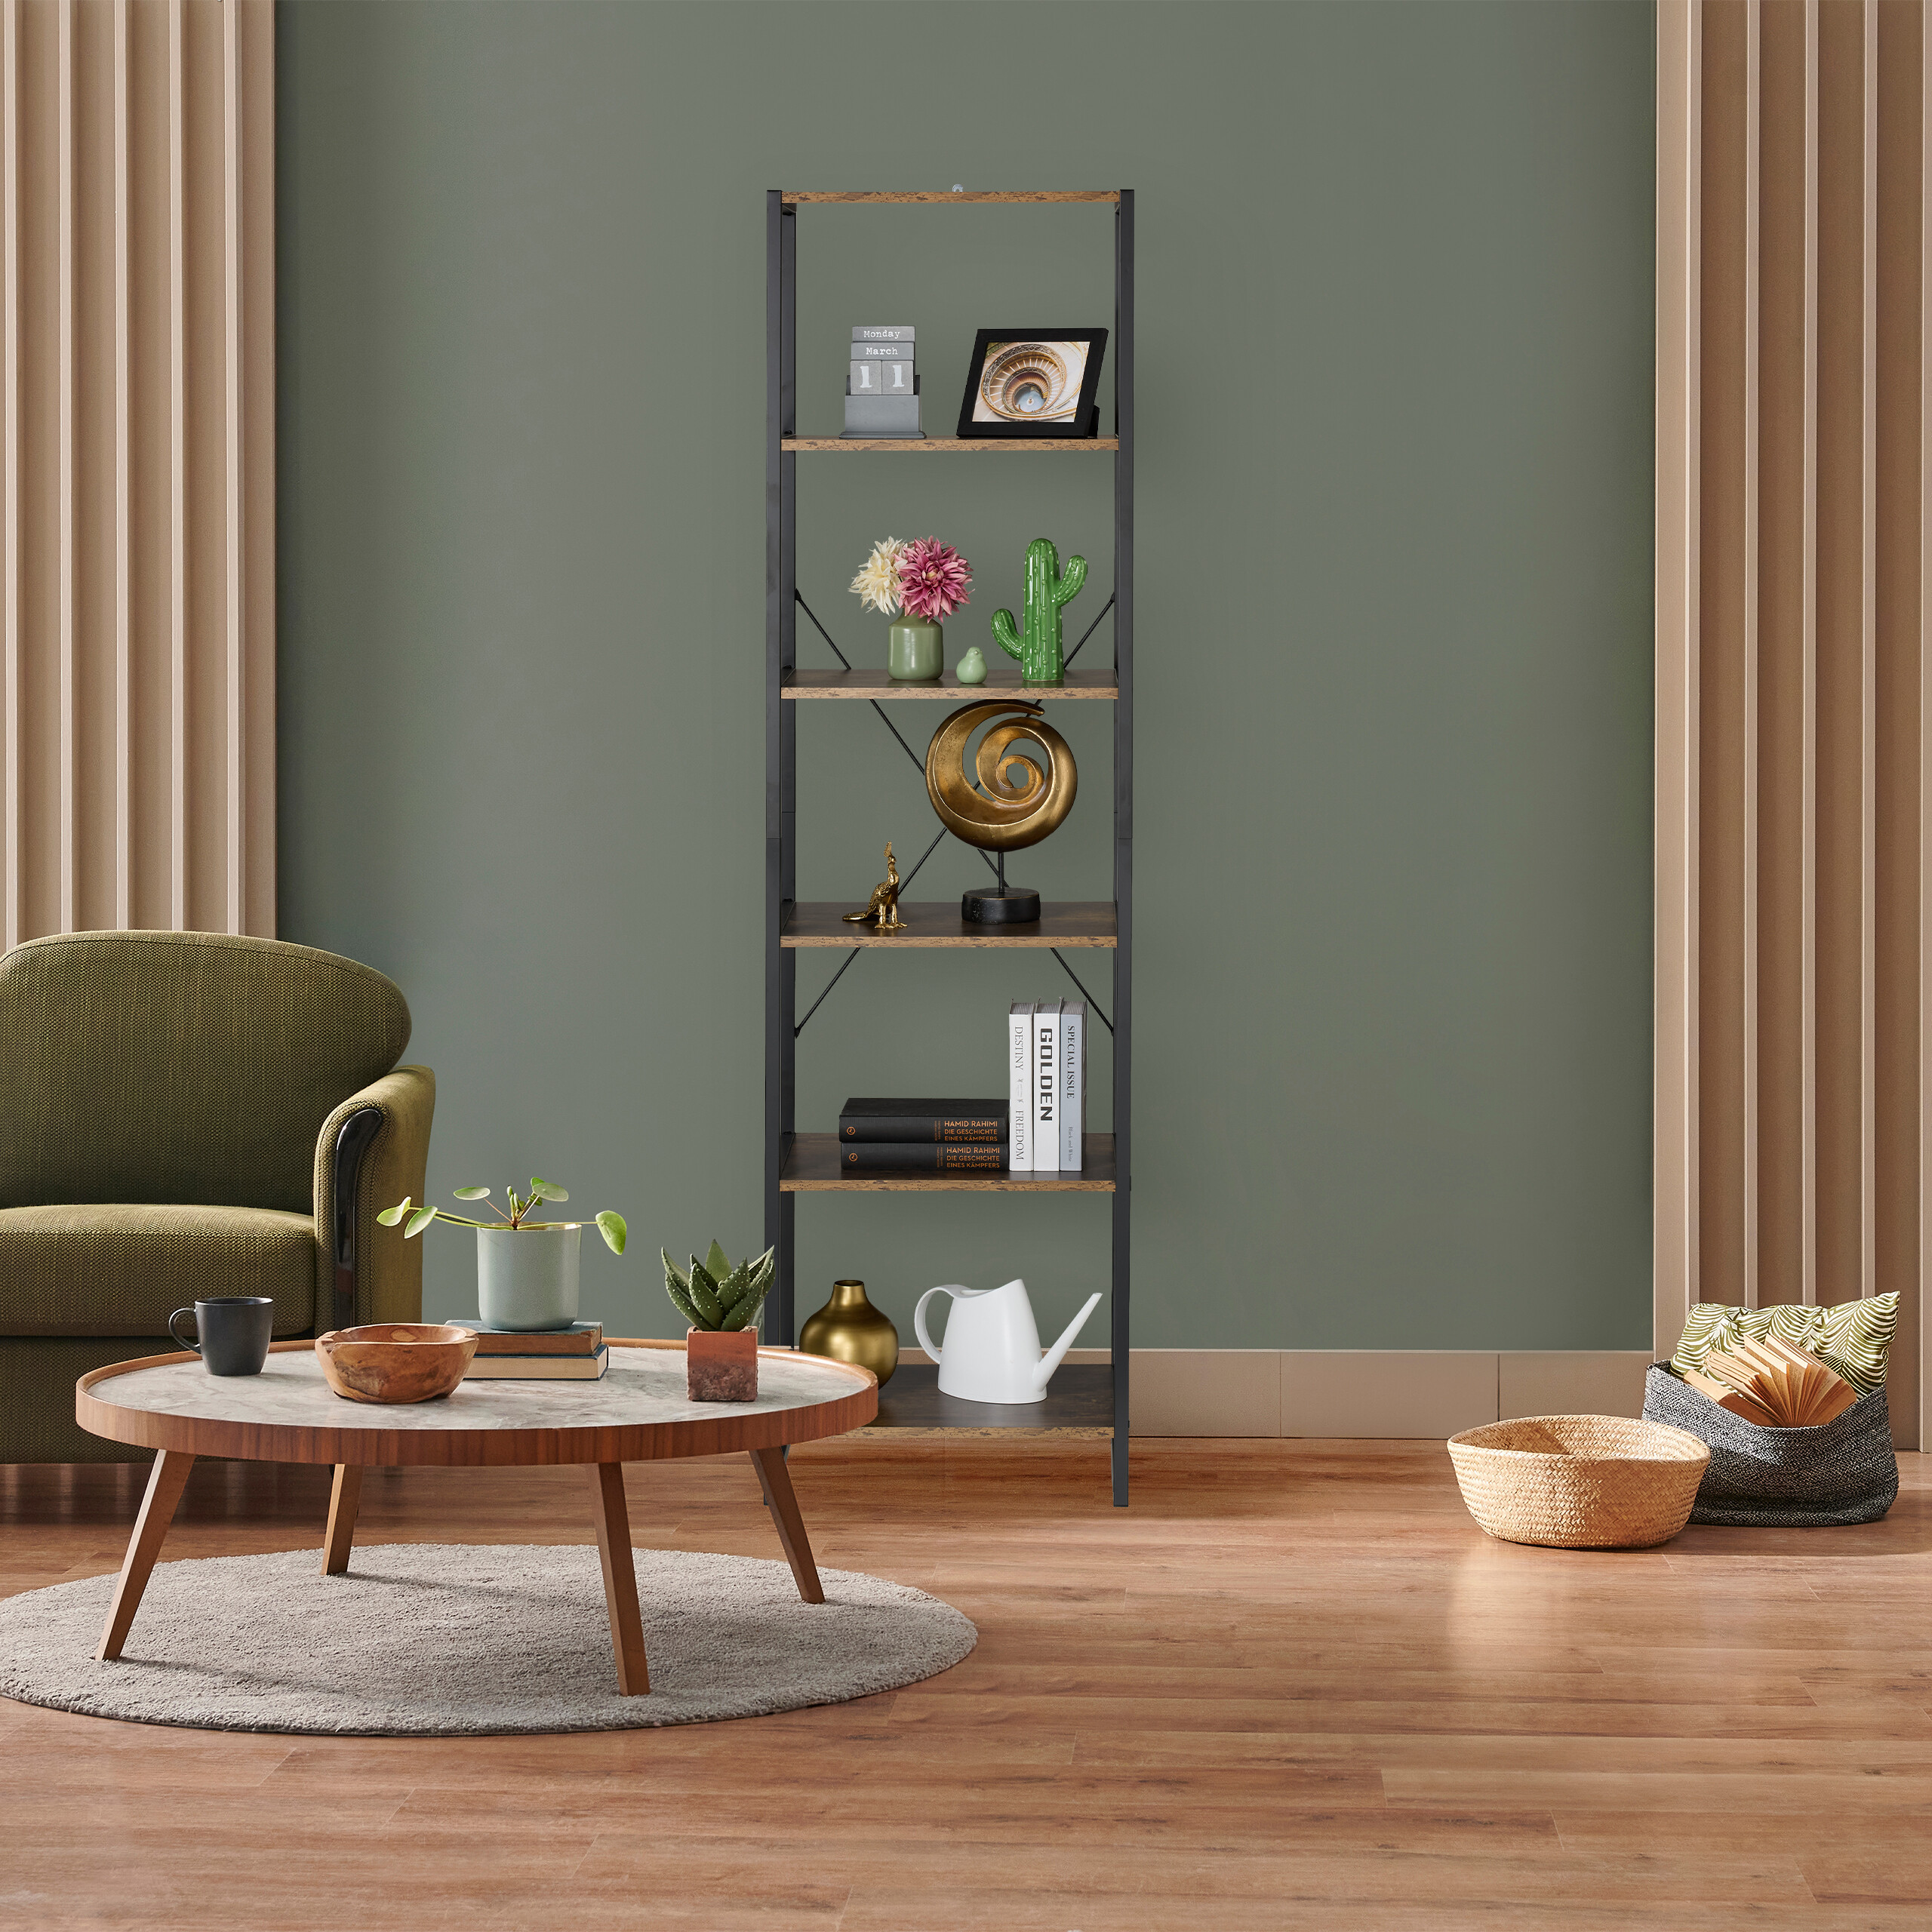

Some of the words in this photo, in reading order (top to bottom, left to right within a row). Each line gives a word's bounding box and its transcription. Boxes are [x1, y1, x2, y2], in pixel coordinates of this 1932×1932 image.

[863, 330, 900, 339] Monday
[1014, 1026, 1023, 1070] DESTINY
[1066, 1026, 1075, 1068] SPECIAL
[1040, 1028, 1053, 1121] GOLDEN
[1066, 1071, 1075, 1099] ISSUE
[1015, 1110, 1025, 1160] FREEDOM
